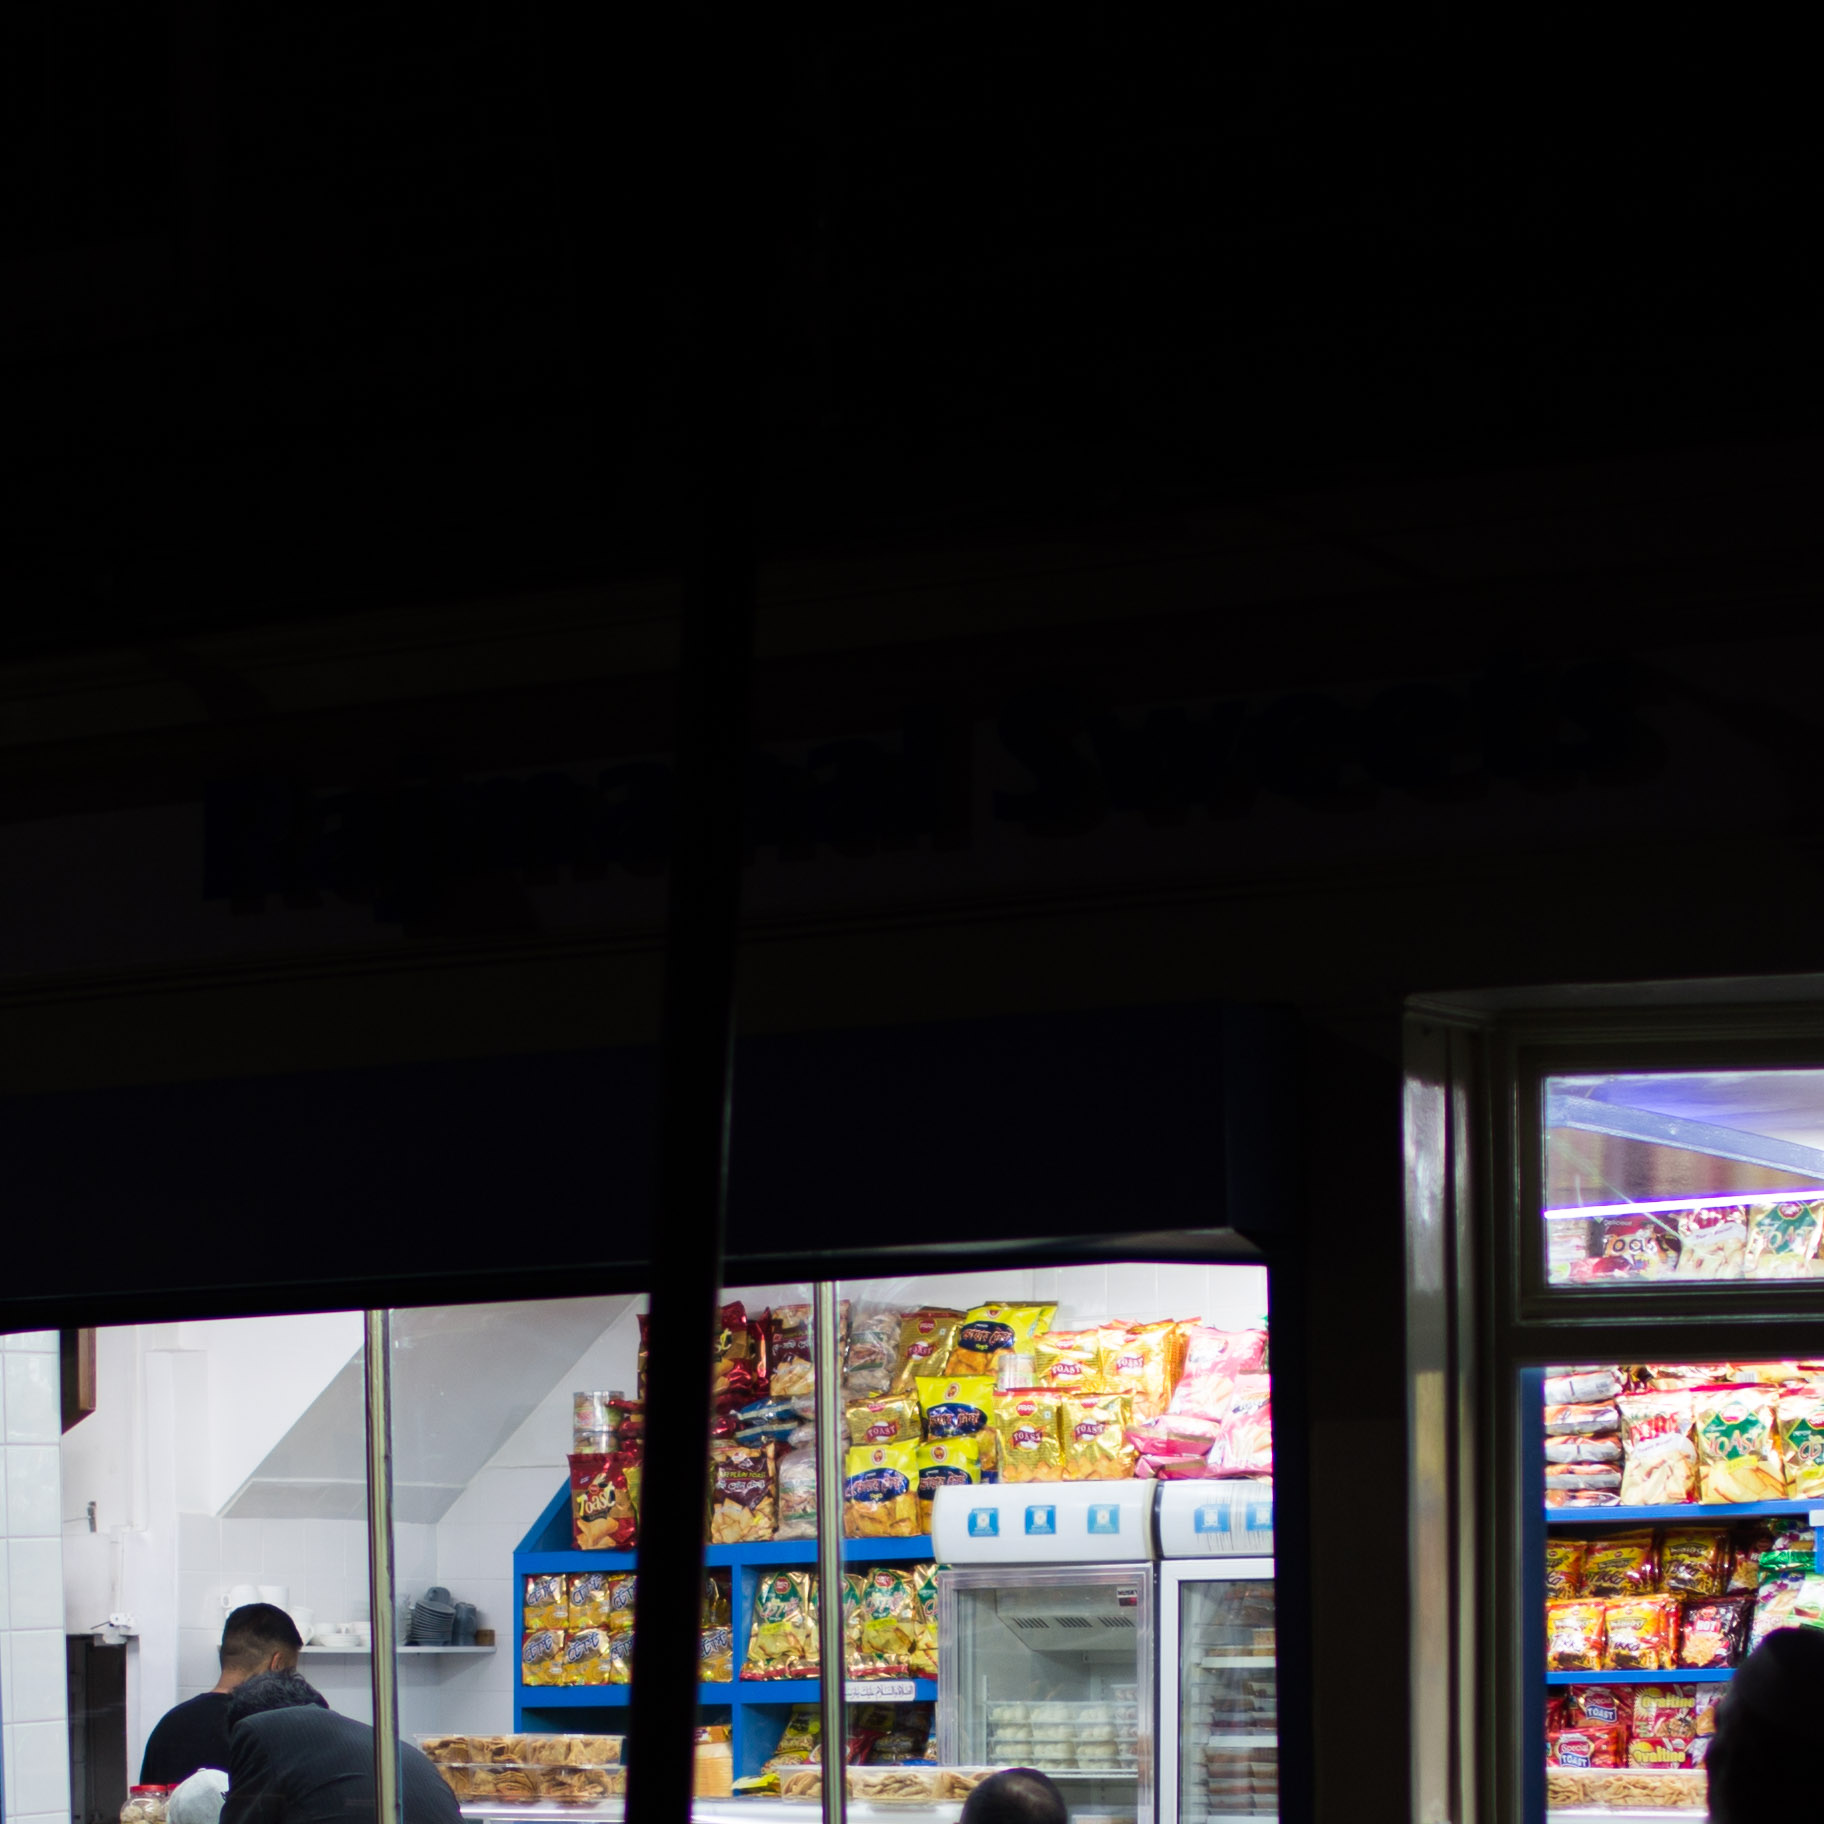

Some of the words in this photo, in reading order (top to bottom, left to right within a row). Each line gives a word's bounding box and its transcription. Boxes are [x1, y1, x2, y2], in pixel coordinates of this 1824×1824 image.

[991, 648, 1636, 823] Sweets
[1051, 1362, 1082, 1375] TOAST
[867, 1425, 897, 1437] TOAST
[1076, 1423, 1105, 1436] TOAST
[1707, 1429, 1759, 1457] TOAST
[577, 1482, 616, 1517] Toast
[1696, 1620, 1717, 1632] HOT
[1640, 1692, 1696, 1709] Ovaltine
[1586, 1706, 1615, 1720] TOAST
[1562, 1753, 1589, 1768] TOAST
[1635, 1746, 1687, 1763] Ovaltine
